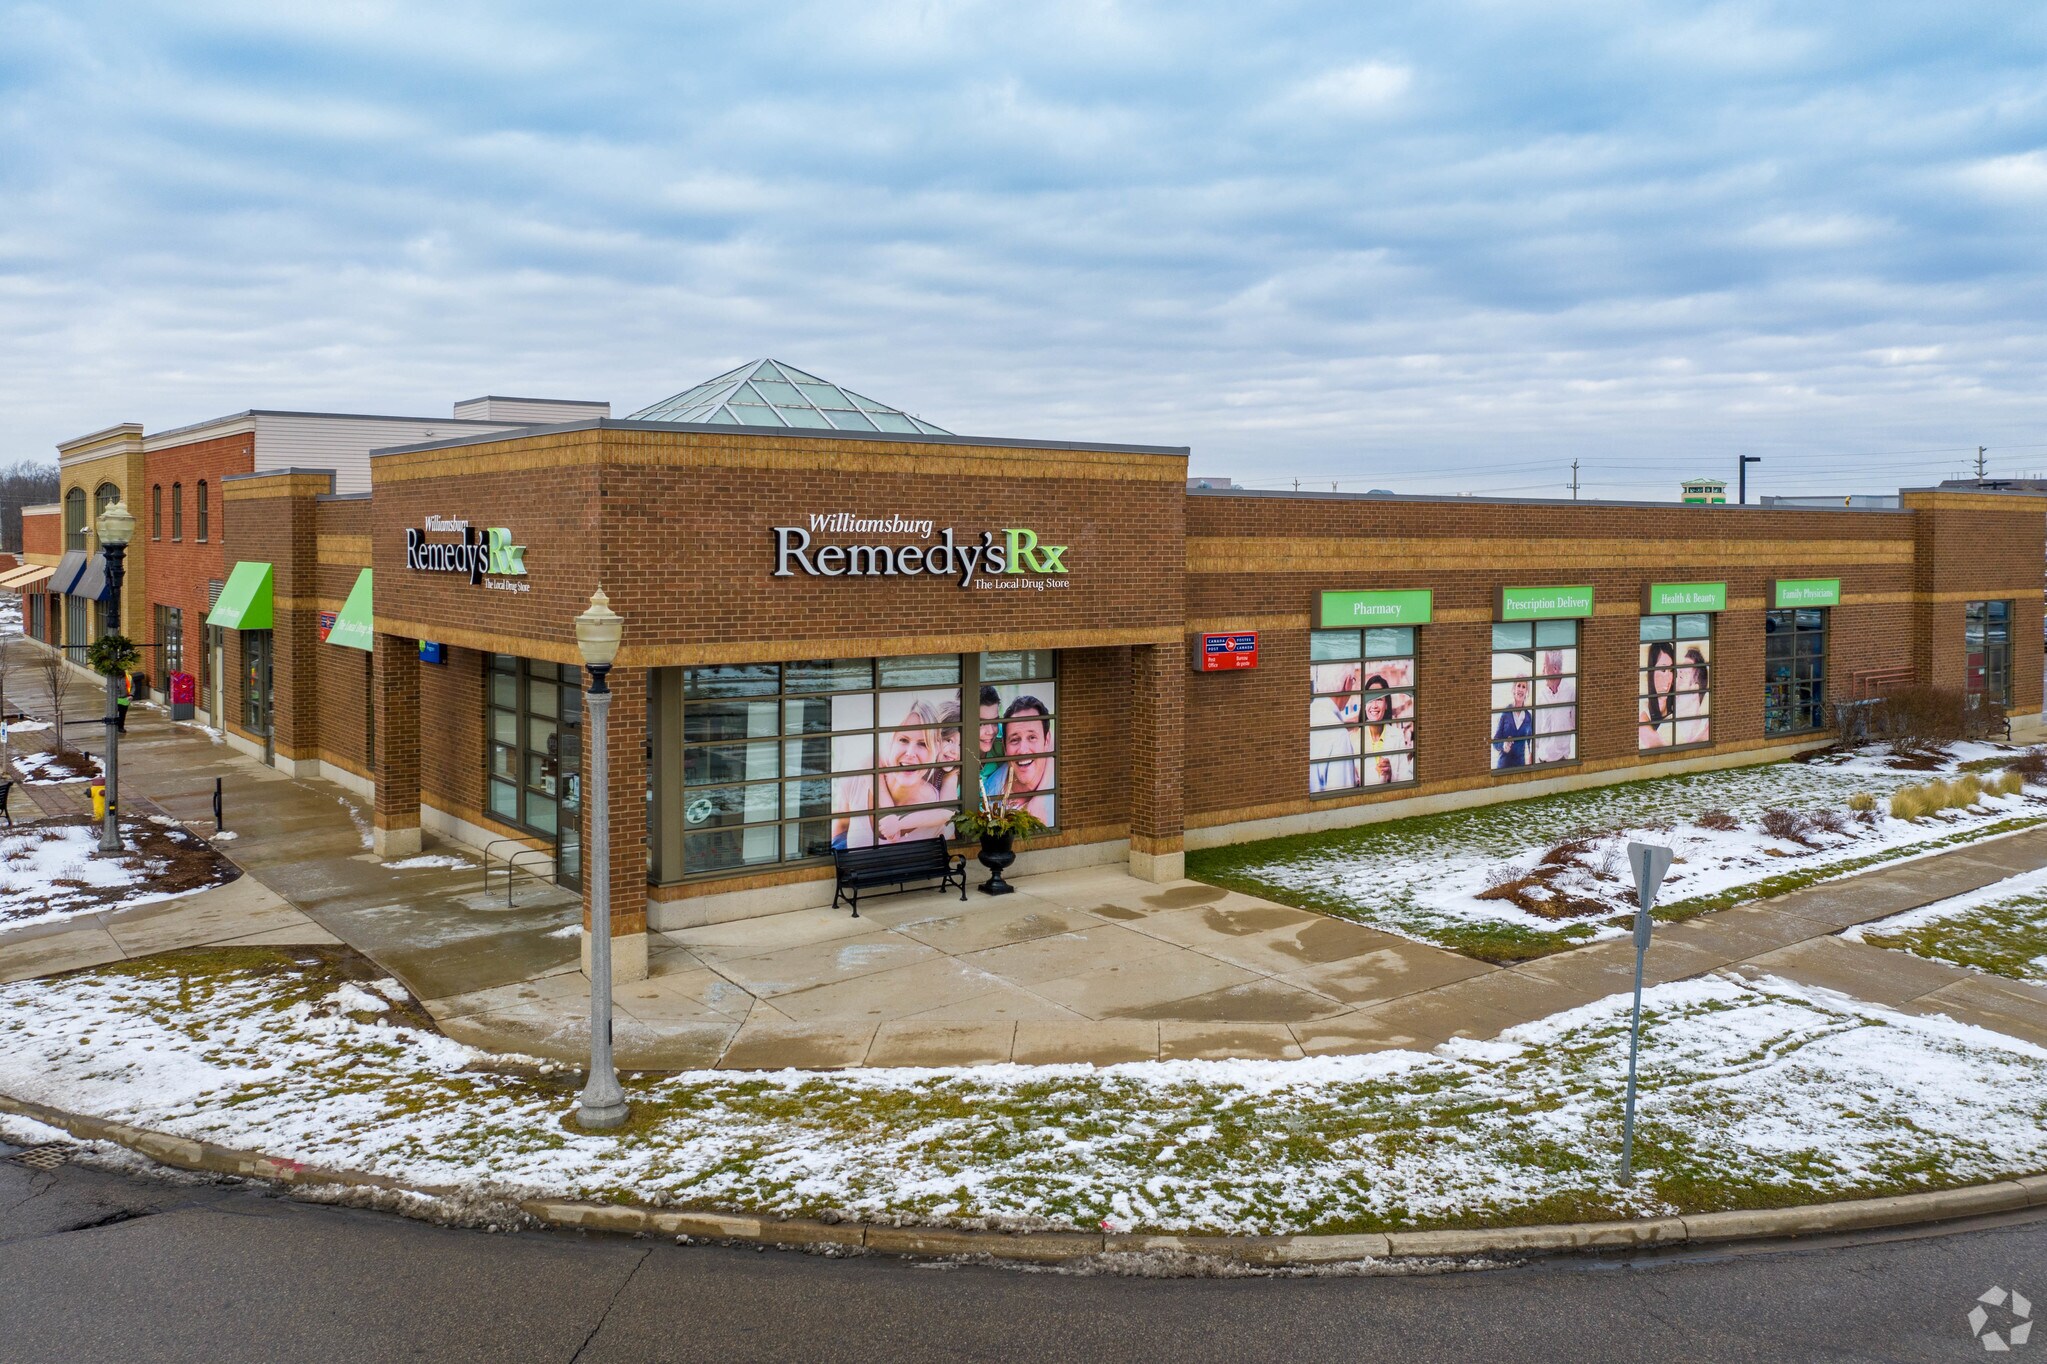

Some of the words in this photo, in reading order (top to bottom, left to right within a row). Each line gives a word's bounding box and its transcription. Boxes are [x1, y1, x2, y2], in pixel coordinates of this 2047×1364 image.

[809, 513, 933, 538] Williamsburg
[485, 578, 494, 589] The
[494, 579, 505, 590] Local
[506, 580, 518, 594] Drug
[517, 581, 530, 592] Store
[974, 579, 993, 589] The
[995, 578, 1019, 589] Local
[1021, 578, 1044, 591] Drug
[1046, 578, 1070, 588] Store
[1661, 593, 1684, 604] Health
[1685, 593, 1691, 603] &
[1693, 592, 1715, 605] Beauty
[1782, 588, 1802, 600] Family
[1803, 588, 1833, 600] Physicians
[1353, 601, 1401, 617] Pharmacy
[1506, 598, 1555, 612] Prescription
[1557, 596, 1589, 610] Delivery
